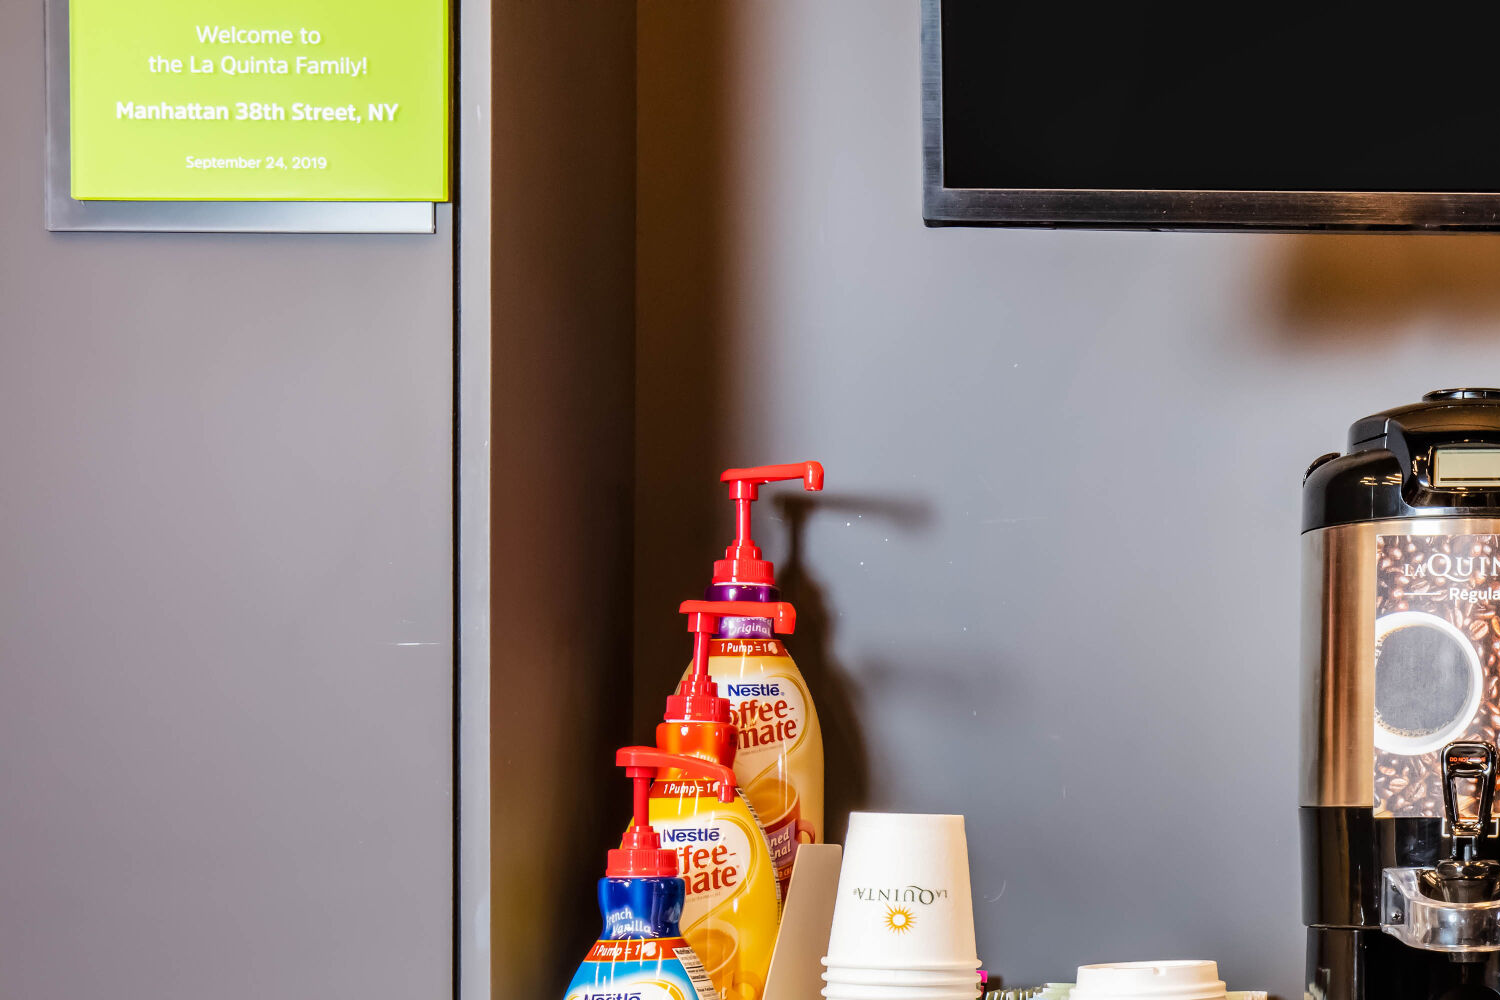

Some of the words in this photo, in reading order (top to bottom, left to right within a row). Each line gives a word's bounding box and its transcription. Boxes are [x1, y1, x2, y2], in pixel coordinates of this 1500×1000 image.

[196, 25, 294, 45] Welcome
[299, 27, 321, 45] to
[148, 56, 183, 74] the
[190, 56, 214, 74] La
[220, 56, 288, 76] Quinta
[296, 56, 367, 77] Family!
[116, 101, 229, 121] Manhattan
[235, 102, 286, 121] 38th
[291, 103, 362, 123] Street,
[368, 103, 399, 121] NY
[186, 156, 262, 170] September
[265, 156, 288, 171] 24,
[292, 156, 327, 169] 2019
[1404, 563, 1426, 577] LA
[720, 643, 725, 653] 1
[727, 642, 754, 655] Pump
[737, 719, 797, 750] mate
[668, 783, 695, 796] Pump
[856, 885, 936, 905] QUINTA
[597, 944, 623, 957] Pump
